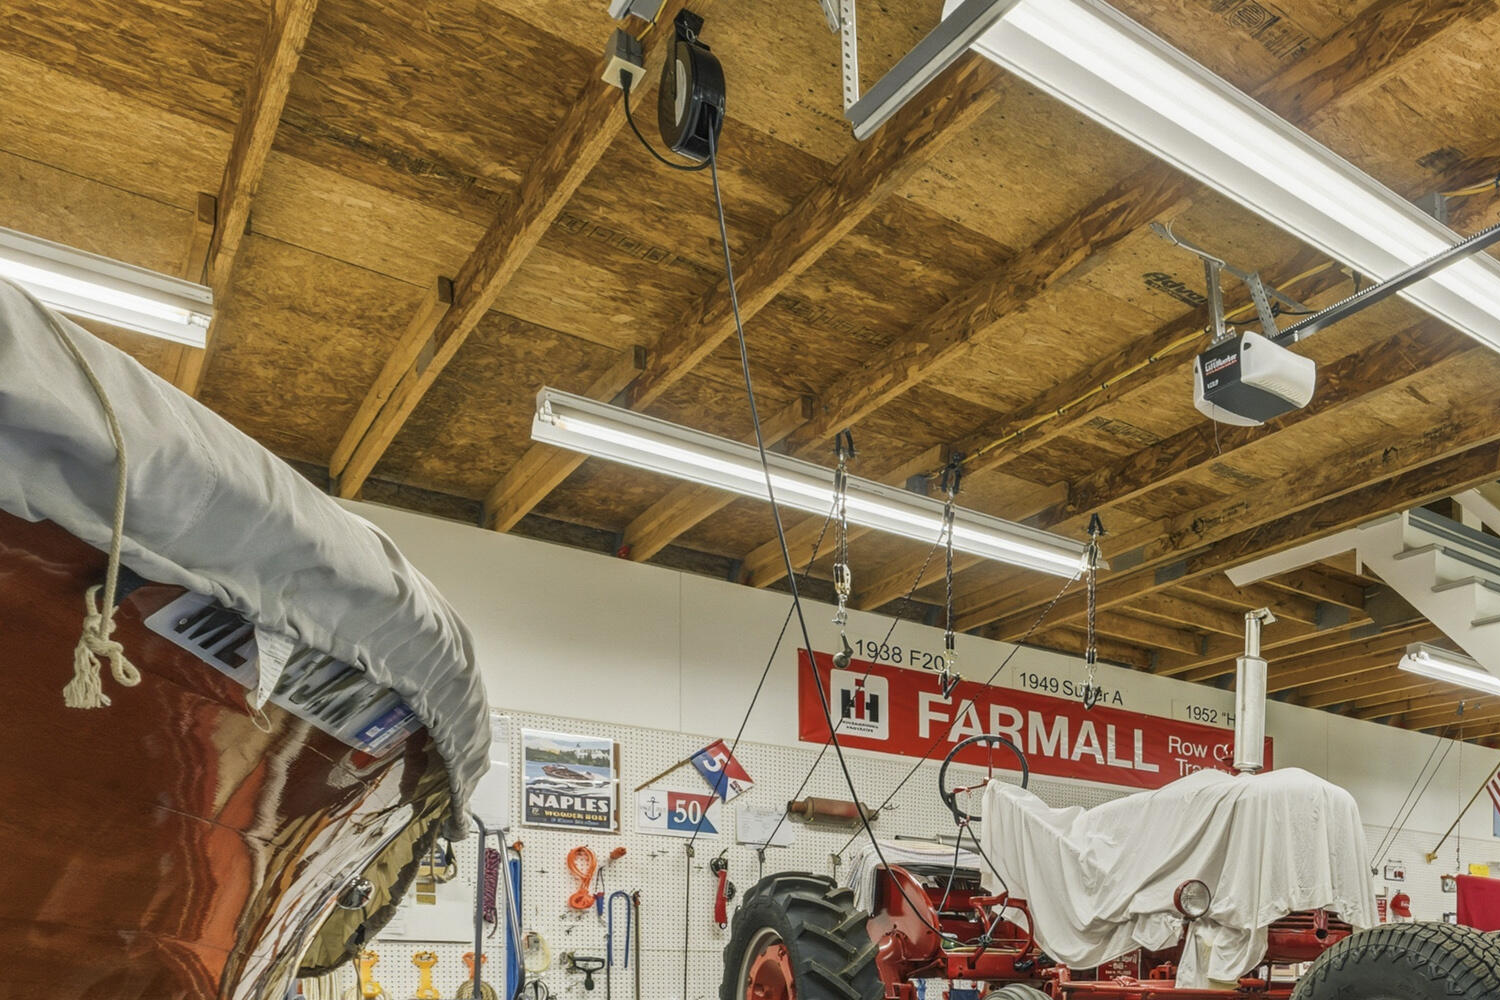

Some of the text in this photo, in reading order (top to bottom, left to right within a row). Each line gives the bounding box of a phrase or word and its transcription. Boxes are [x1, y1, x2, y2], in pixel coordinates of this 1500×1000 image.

[855, 640, 945, 671] 1938 F20
[1019, 673, 1059, 693] 1949
[1111, 690, 1123, 706] A
[1185, 705, 1218, 724] 1952
[918, 690, 1160, 773] FARMALL
[1168, 735, 1208, 759] Row
[528, 792, 609, 813] NAPLES
[673, 799, 702, 825] 50
